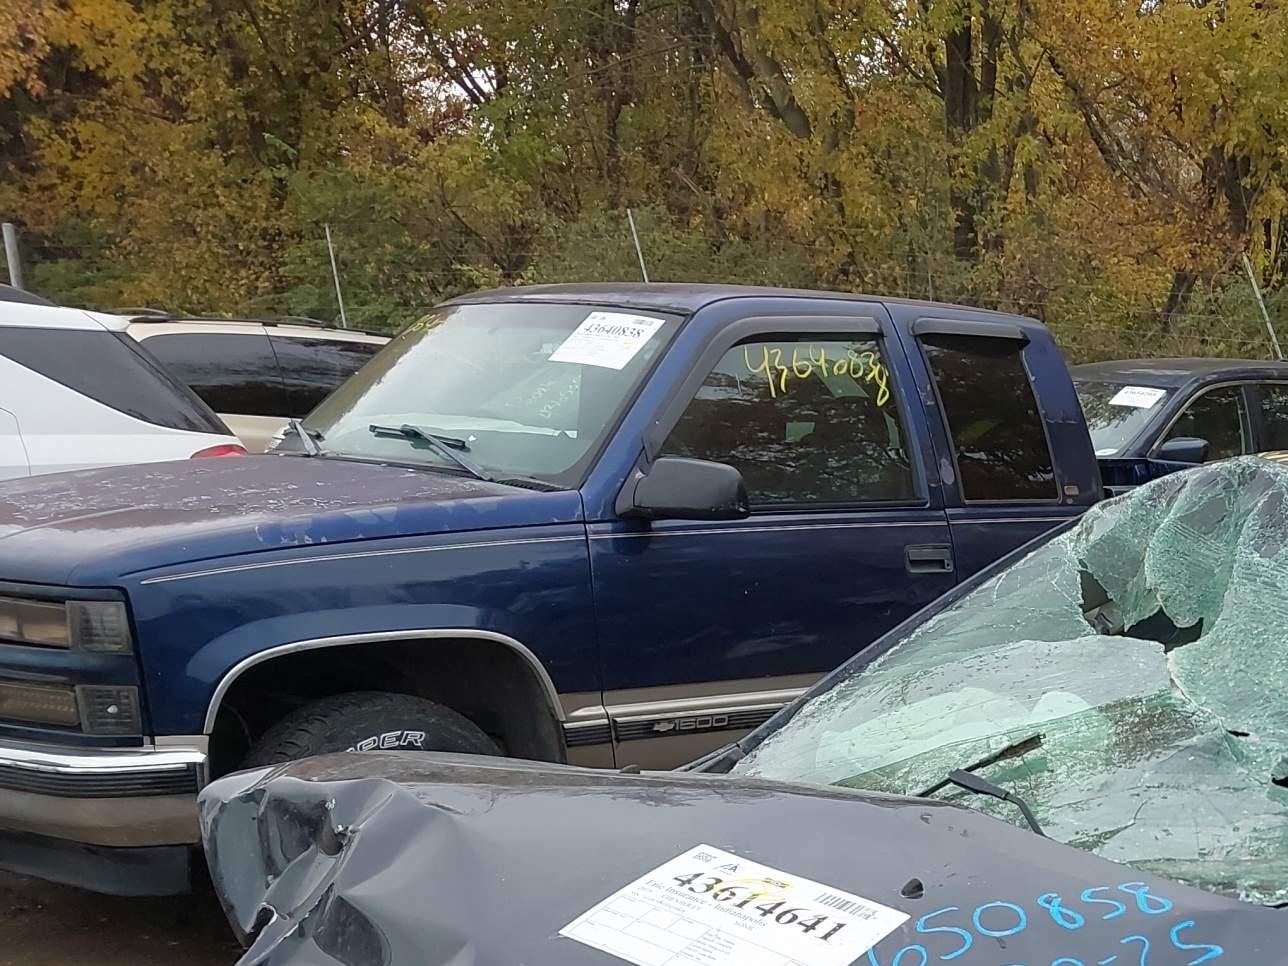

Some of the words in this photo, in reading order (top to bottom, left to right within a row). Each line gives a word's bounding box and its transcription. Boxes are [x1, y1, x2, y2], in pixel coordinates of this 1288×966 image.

[675, 716, 728, 731] 1500
[664, 886, 708, 904] Insurance
[712, 903, 769, 927] Indianapolis
[673, 872, 846, 941] 43614641
